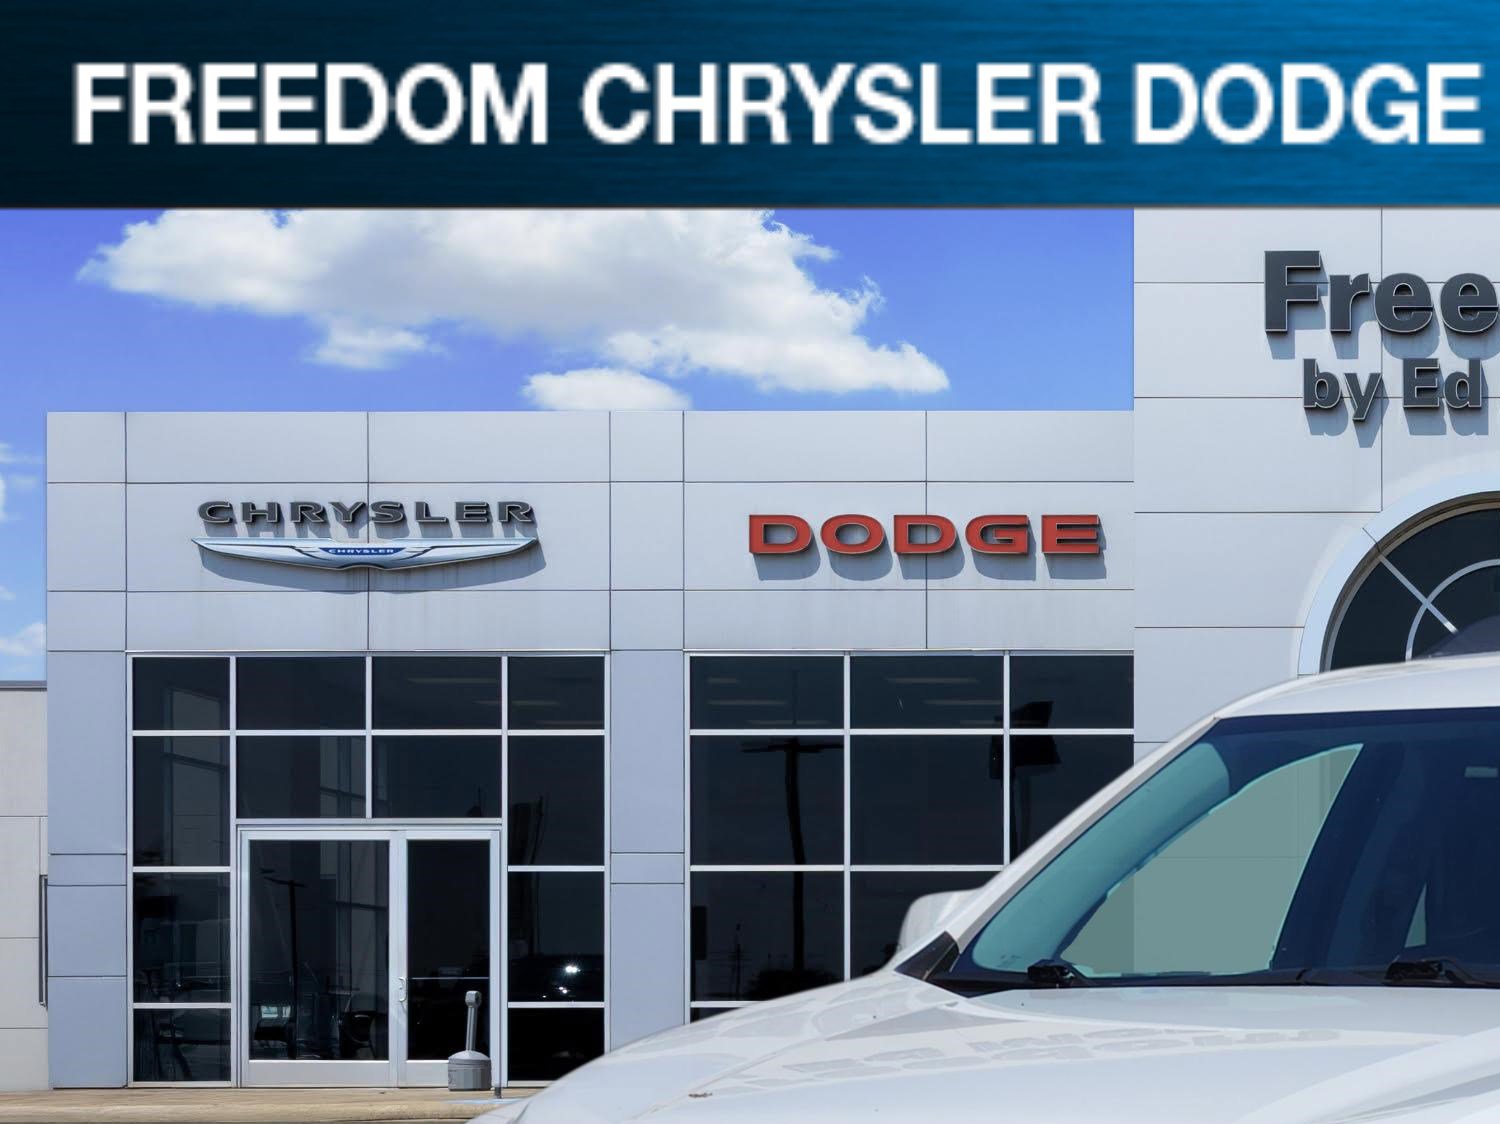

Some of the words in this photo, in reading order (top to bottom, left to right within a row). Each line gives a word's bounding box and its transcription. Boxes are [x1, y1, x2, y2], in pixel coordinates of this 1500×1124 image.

[1302, 358, 1382, 421] by
[1403, 358, 1483, 409] Ed
[197, 500, 536, 524] CHRYSLER
[748, 513, 1101, 554] DODGE
